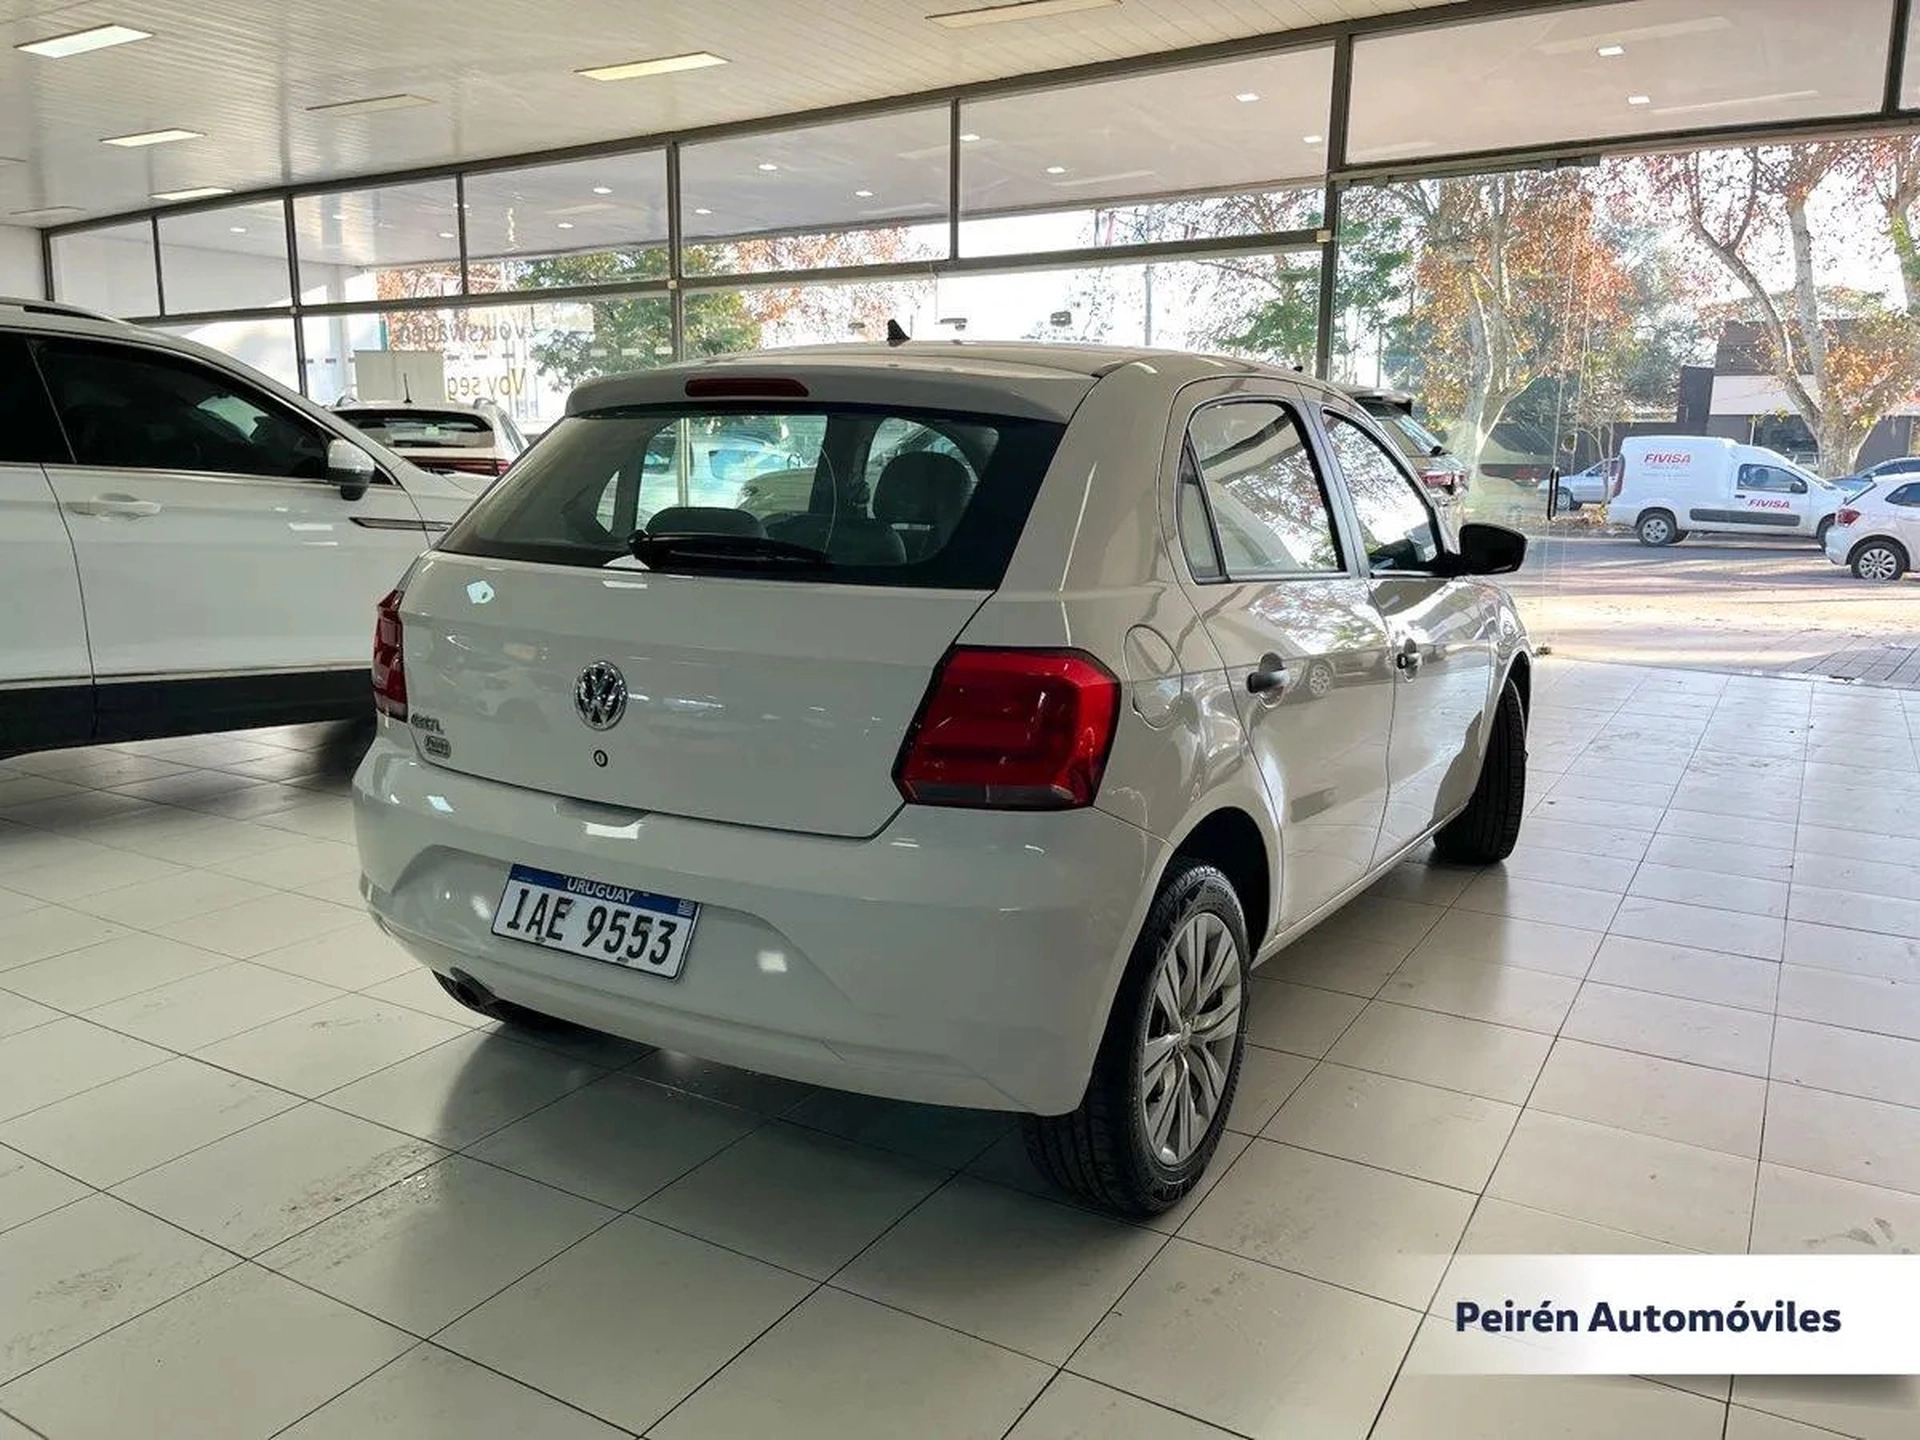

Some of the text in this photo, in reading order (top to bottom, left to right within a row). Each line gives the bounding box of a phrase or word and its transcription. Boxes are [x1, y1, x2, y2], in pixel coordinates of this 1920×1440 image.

[1644, 453, 1691, 463] FIVISA
[1749, 499, 1790, 509] FIVISA
[567, 878, 635, 903] URUGUAY
[507, 888, 678, 965] IAE 9553
